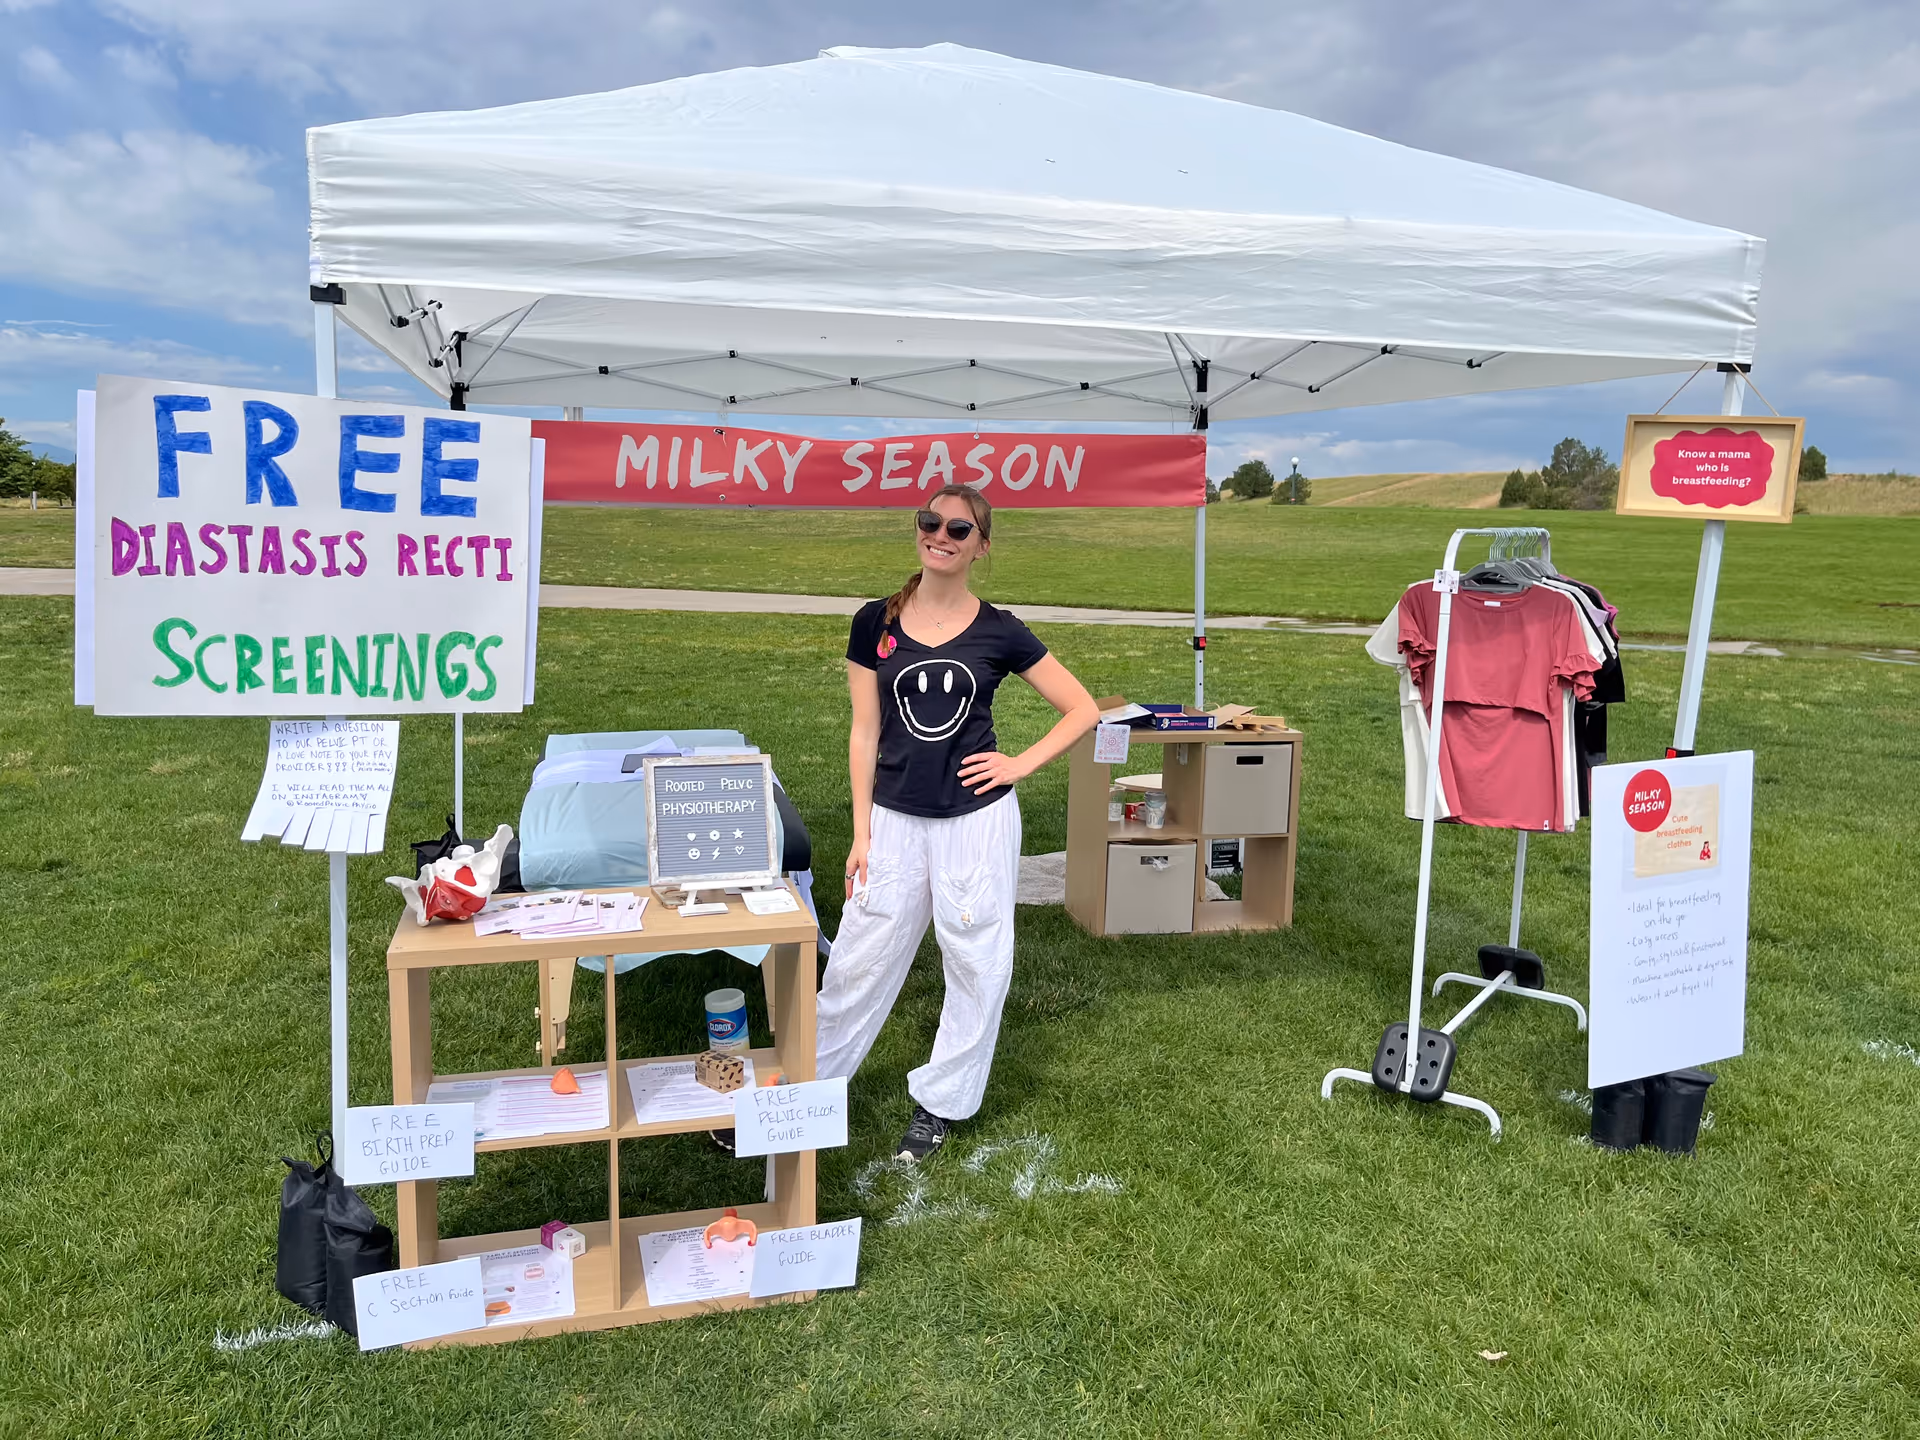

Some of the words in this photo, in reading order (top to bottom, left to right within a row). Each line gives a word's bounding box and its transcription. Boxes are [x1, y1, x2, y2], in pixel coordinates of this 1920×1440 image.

[153, 394, 483, 518] FREE
[1678, 449, 1707, 459] Know
[1709, 451, 1716, 459] a
[1717, 451, 1751, 460] mama
[615, 434, 815, 492] MILKY
[841, 441, 1086, 494] SEASON
[1696, 463, 1718, 472] who
[1720, 462, 1729, 472] is
[1672, 476, 1752, 488] breastfeeding?
[111, 516, 368, 578] DIASTASIS
[397, 533, 514, 582] RECTI
[152, 617, 504, 702] SCREENINGS
[275, 722, 313, 735] WRITE
[321, 721, 329, 732] A
[334, 722, 385, 733] QUESTION
[275, 739, 289, 749] TO
[351, 735, 368, 747] PT
[372, 737, 388, 747] OR
[285, 750, 306, 760] LOVE
[310, 750, 332, 759] NOTE
[319, 784, 345, 792] READ
[1634, 788, 1662, 803] MILKY
[662, 799, 757, 816] PHYSIOTHERAPY
[1628, 800, 1665, 815] SEASON
[1671, 814, 1689, 823] Cute
[1656, 825, 1703, 838] breastfeeding
[1666, 841, 1692, 850] clothes
[1632, 899, 1652, 913] Ideal
[1669, 890, 1721, 908] breastfeeding
[1643, 918, 1657, 928] on
[1658, 912, 1672, 924] the
[754, 1087, 800, 1107] FREE
[371, 1113, 440, 1134] FREE
[758, 1108, 804, 1126] PELVIC
[807, 1105, 838, 1118] FLOOR
[767, 1126, 805, 1142] GUIDE
[362, 1135, 414, 1157] BIRTH
[419, 1129, 455, 1150] PREP
[770, 1231, 804, 1245] FREE
[810, 1225, 855, 1241] BLADDER
[778, 1251, 816, 1266] GUIDE
[380, 1272, 431, 1295] FREE
[367, 1302, 379, 1318] C
